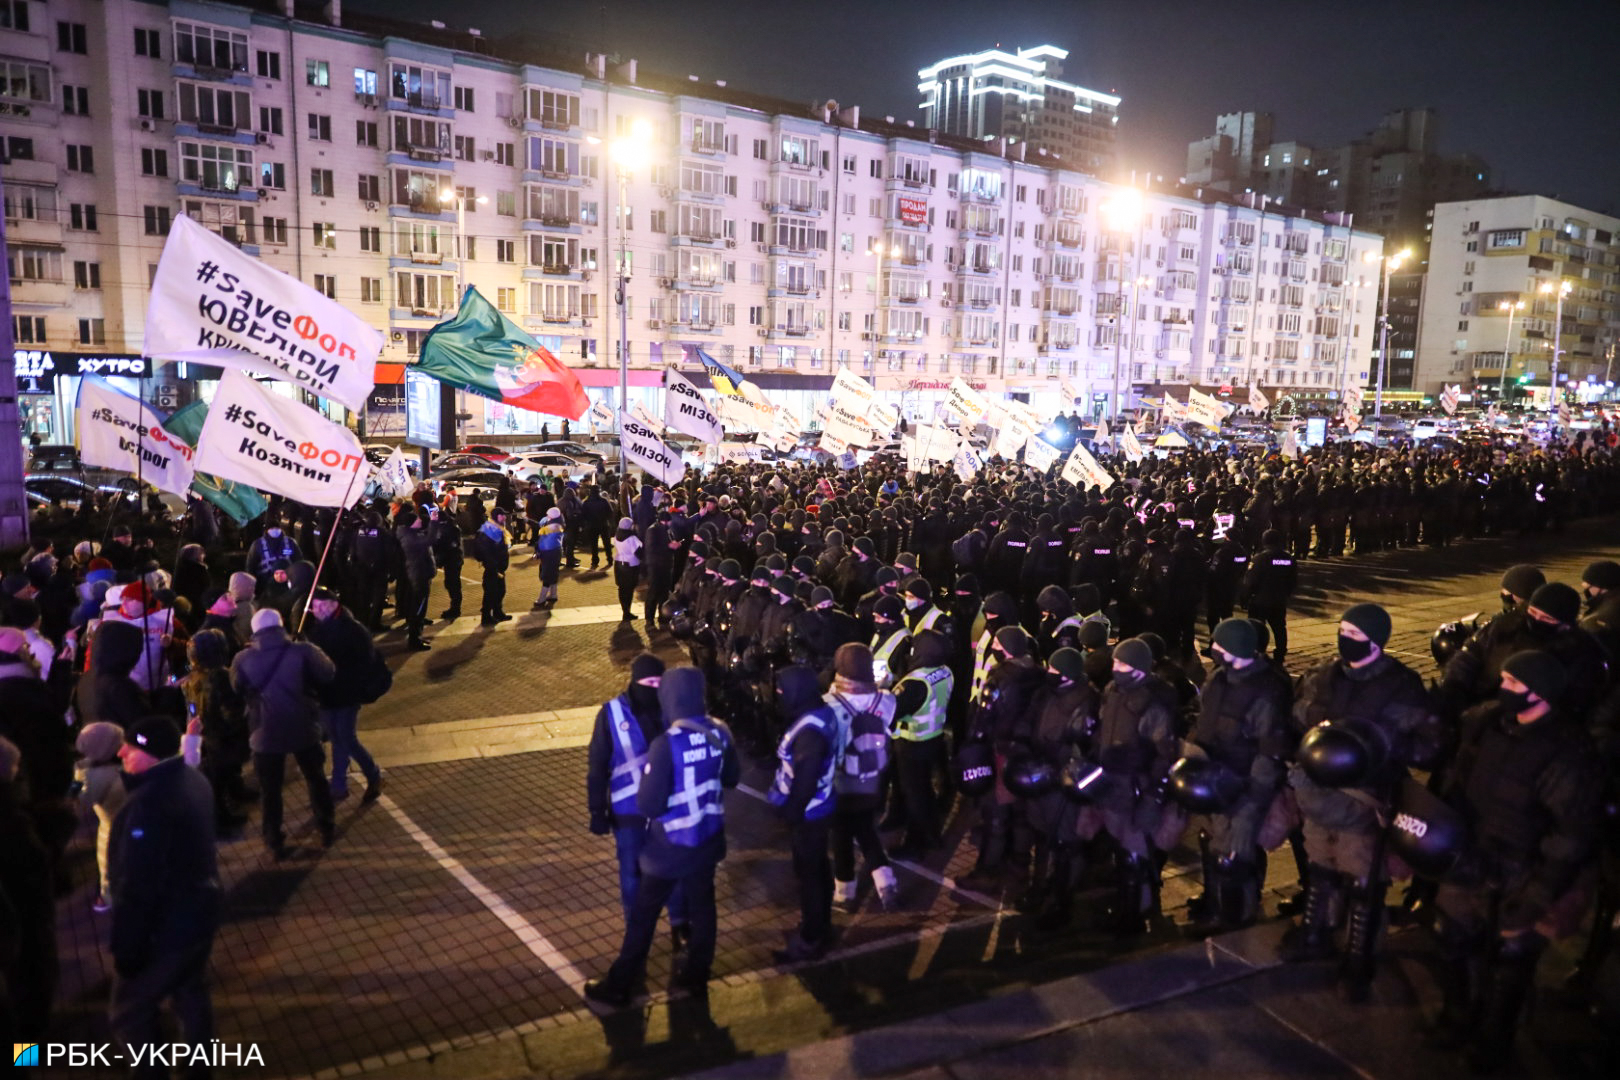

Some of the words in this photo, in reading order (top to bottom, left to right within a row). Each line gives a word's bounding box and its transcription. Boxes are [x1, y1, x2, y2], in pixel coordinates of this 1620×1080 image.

[198, 293, 341, 385] ЮВЕЛІРИ
[78, 358, 146, 373] ХУТРО
[680, 402, 718, 428] МІЗОЧ
[238, 436, 332, 484] Козятин
[631, 442, 672, 468] МІЗОЧ
